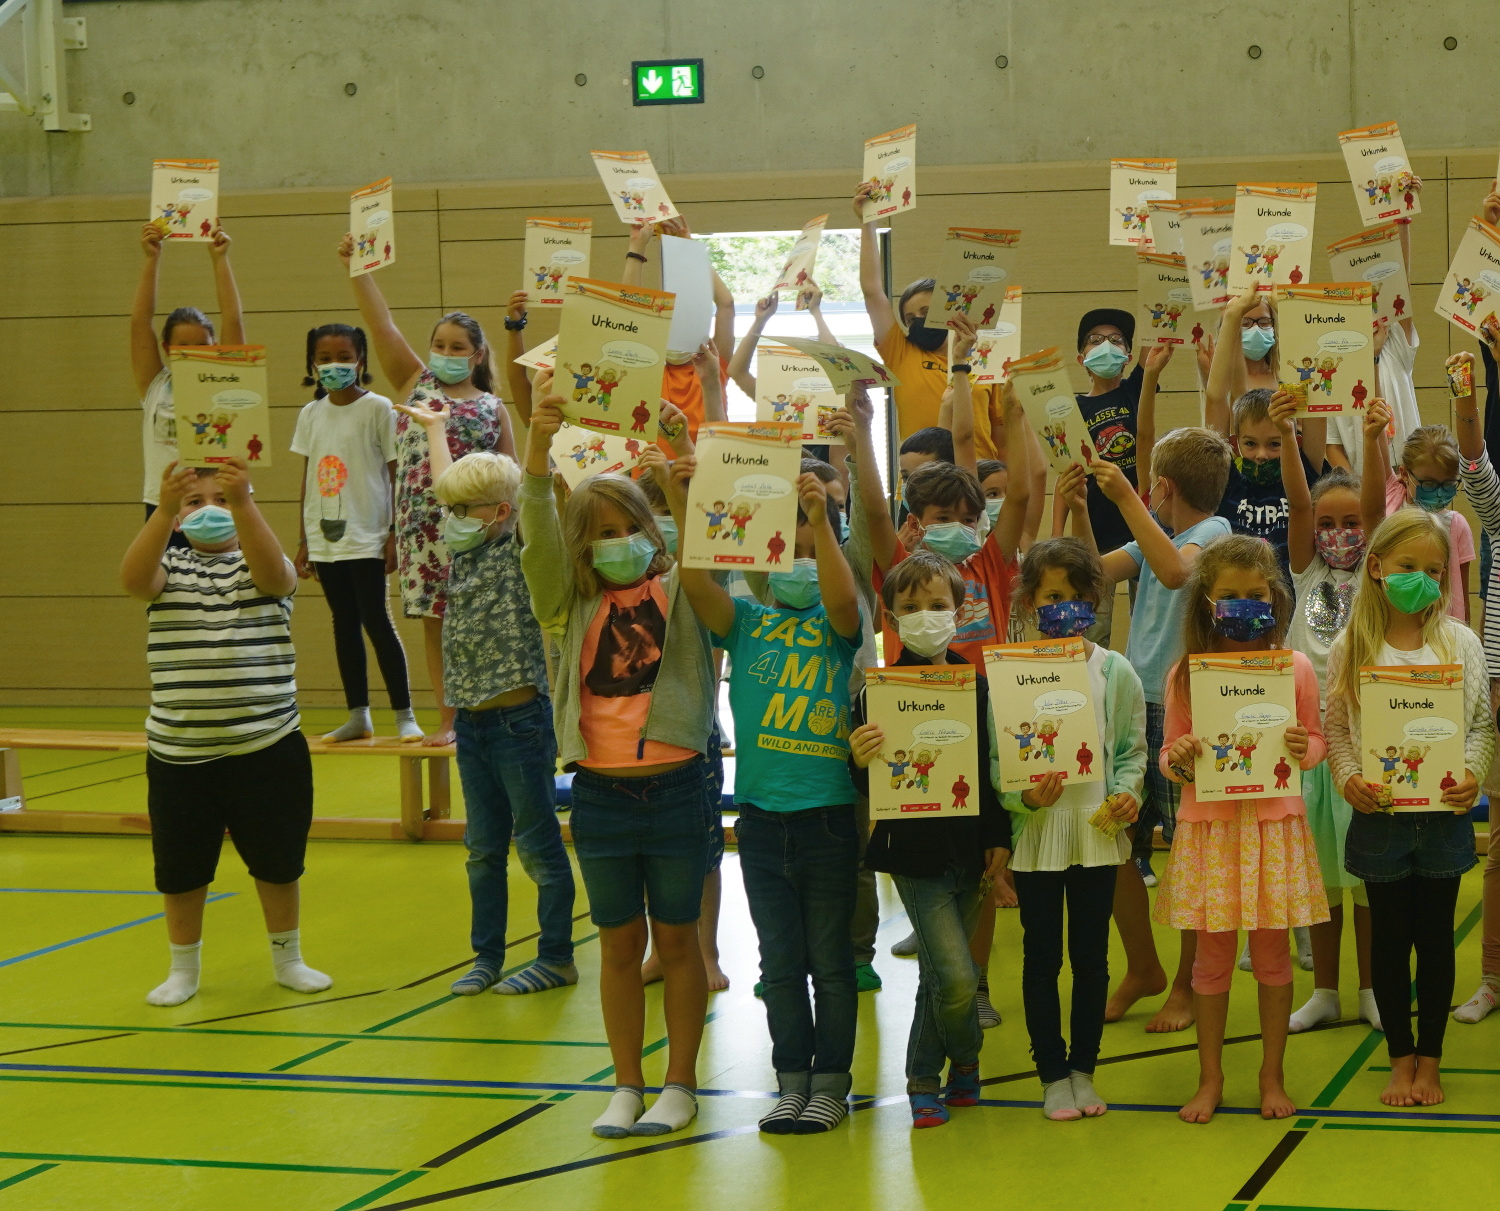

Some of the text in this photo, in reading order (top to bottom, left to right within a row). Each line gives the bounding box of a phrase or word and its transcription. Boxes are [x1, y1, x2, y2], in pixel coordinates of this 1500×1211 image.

[1361, 145, 1388, 157] Urkunde
[1257, 208, 1292, 217] Urkunde
[963, 250, 995, 261] Urkunde
[1349, 251, 1382, 267] Urkunde
[592, 315, 639, 334] Urkunde
[1304, 313, 1346, 324] Urkunde
[781, 364, 820, 373] Urkunde
[198, 373, 240, 383] Urkunde
[1084, 409, 1117, 429] KLASSE
[722, 452, 769, 466] Urkunde
[1016, 672, 1061, 686] Urkunde
[1220, 684, 1266, 698] Urkunde
[897, 700, 946, 713] Urkunde
[1389, 697, 1435, 710] Urkunde
[761, 736, 792, 750] WILD
[792, 741, 820, 753] AND
